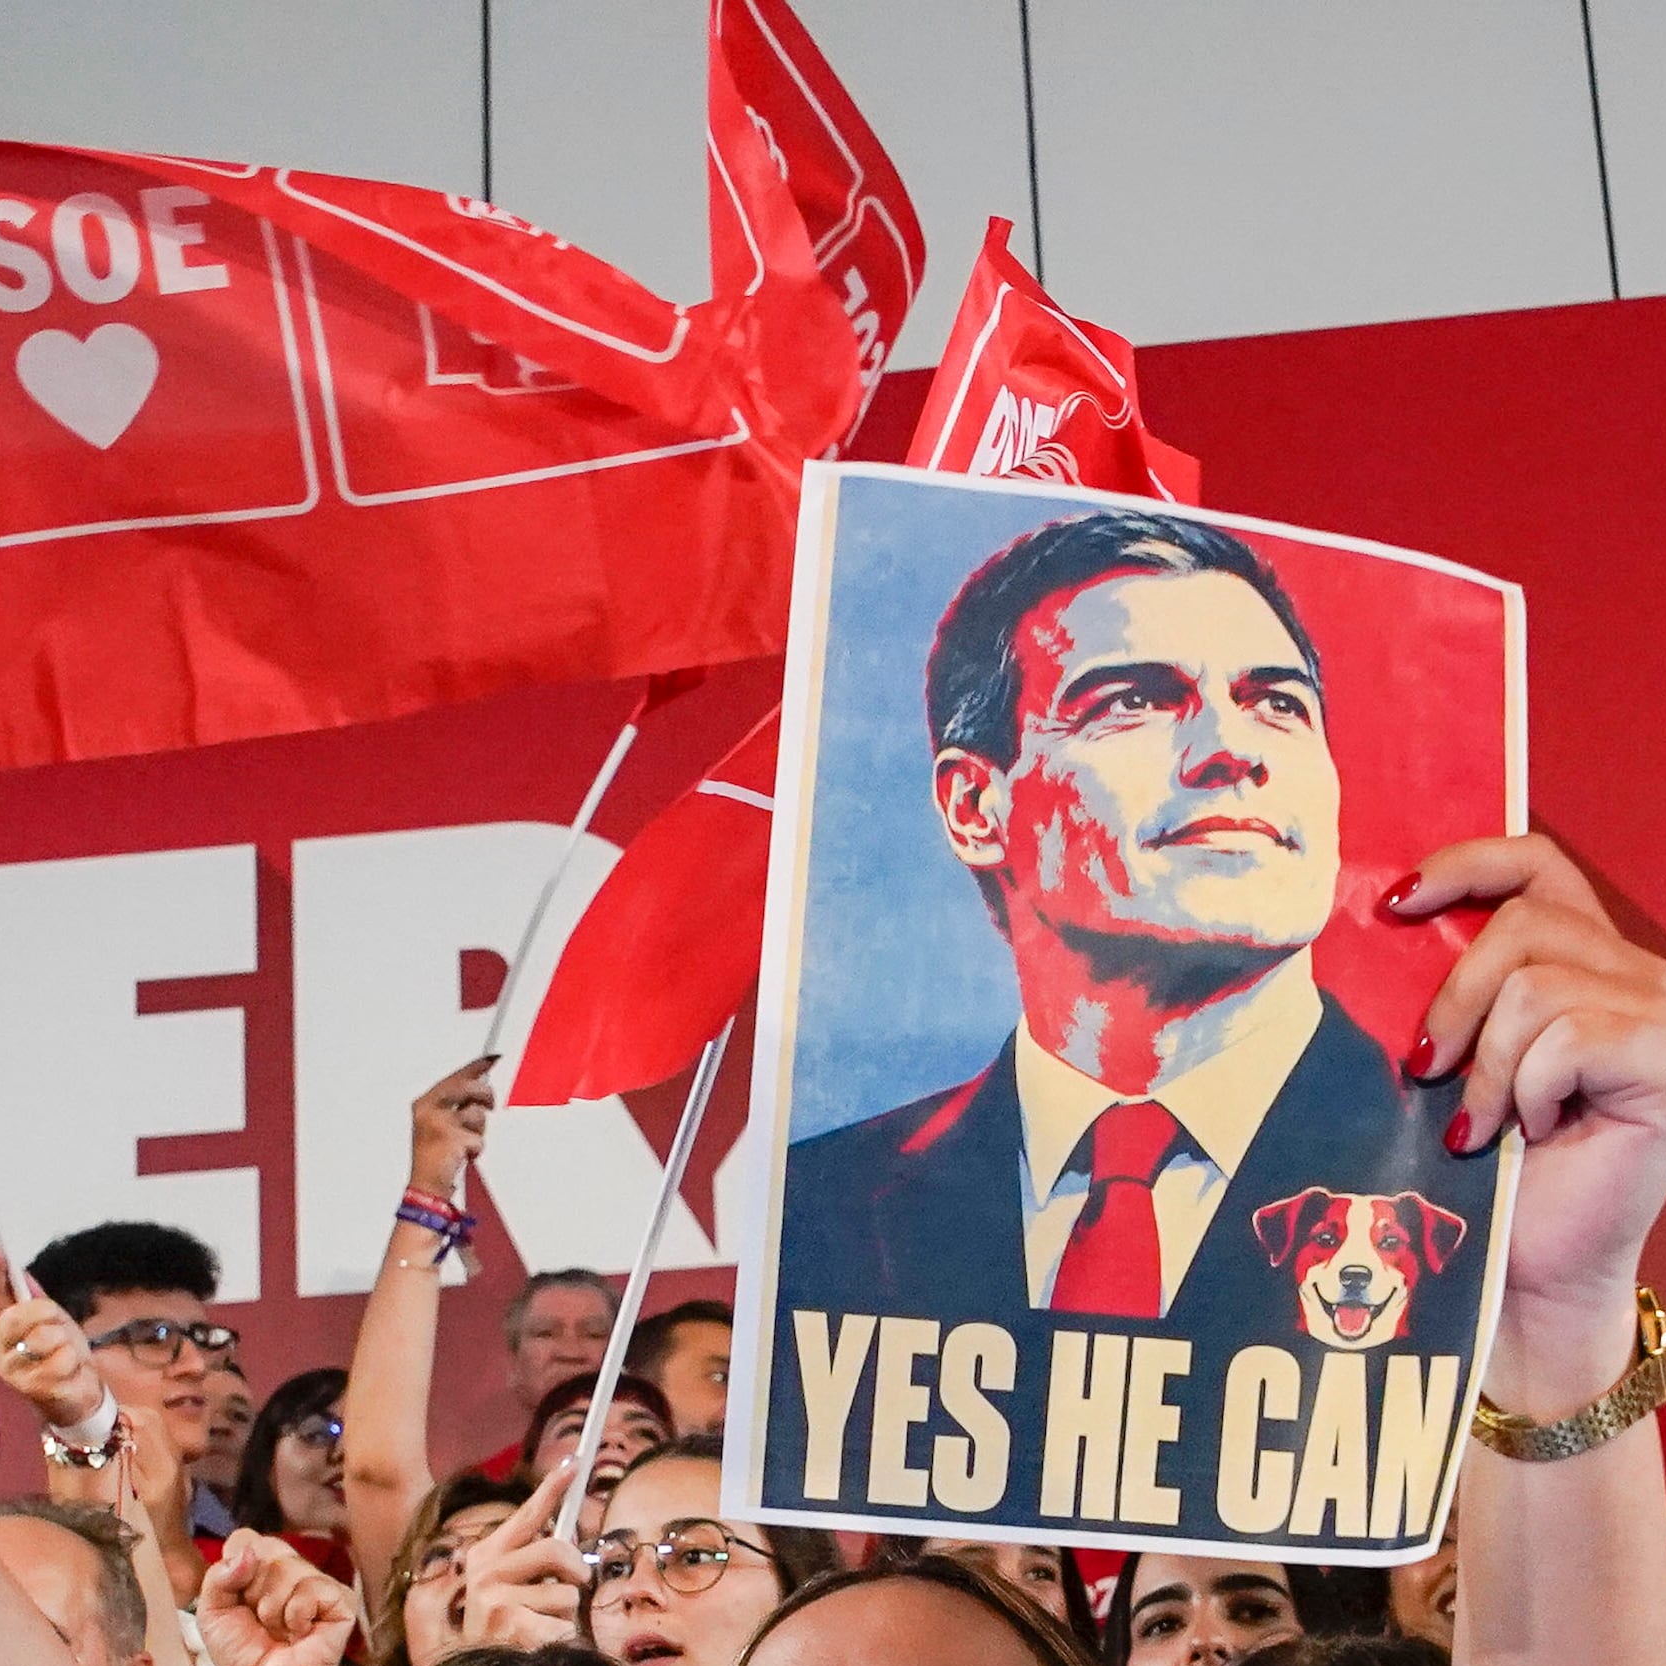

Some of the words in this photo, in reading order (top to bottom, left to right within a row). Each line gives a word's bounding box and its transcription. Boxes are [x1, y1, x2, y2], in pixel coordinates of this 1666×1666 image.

[792, 1310, 1018, 1513] YES
[1038, 1330, 1193, 1527] HE
[1215, 1343, 1461, 1540] CAN
